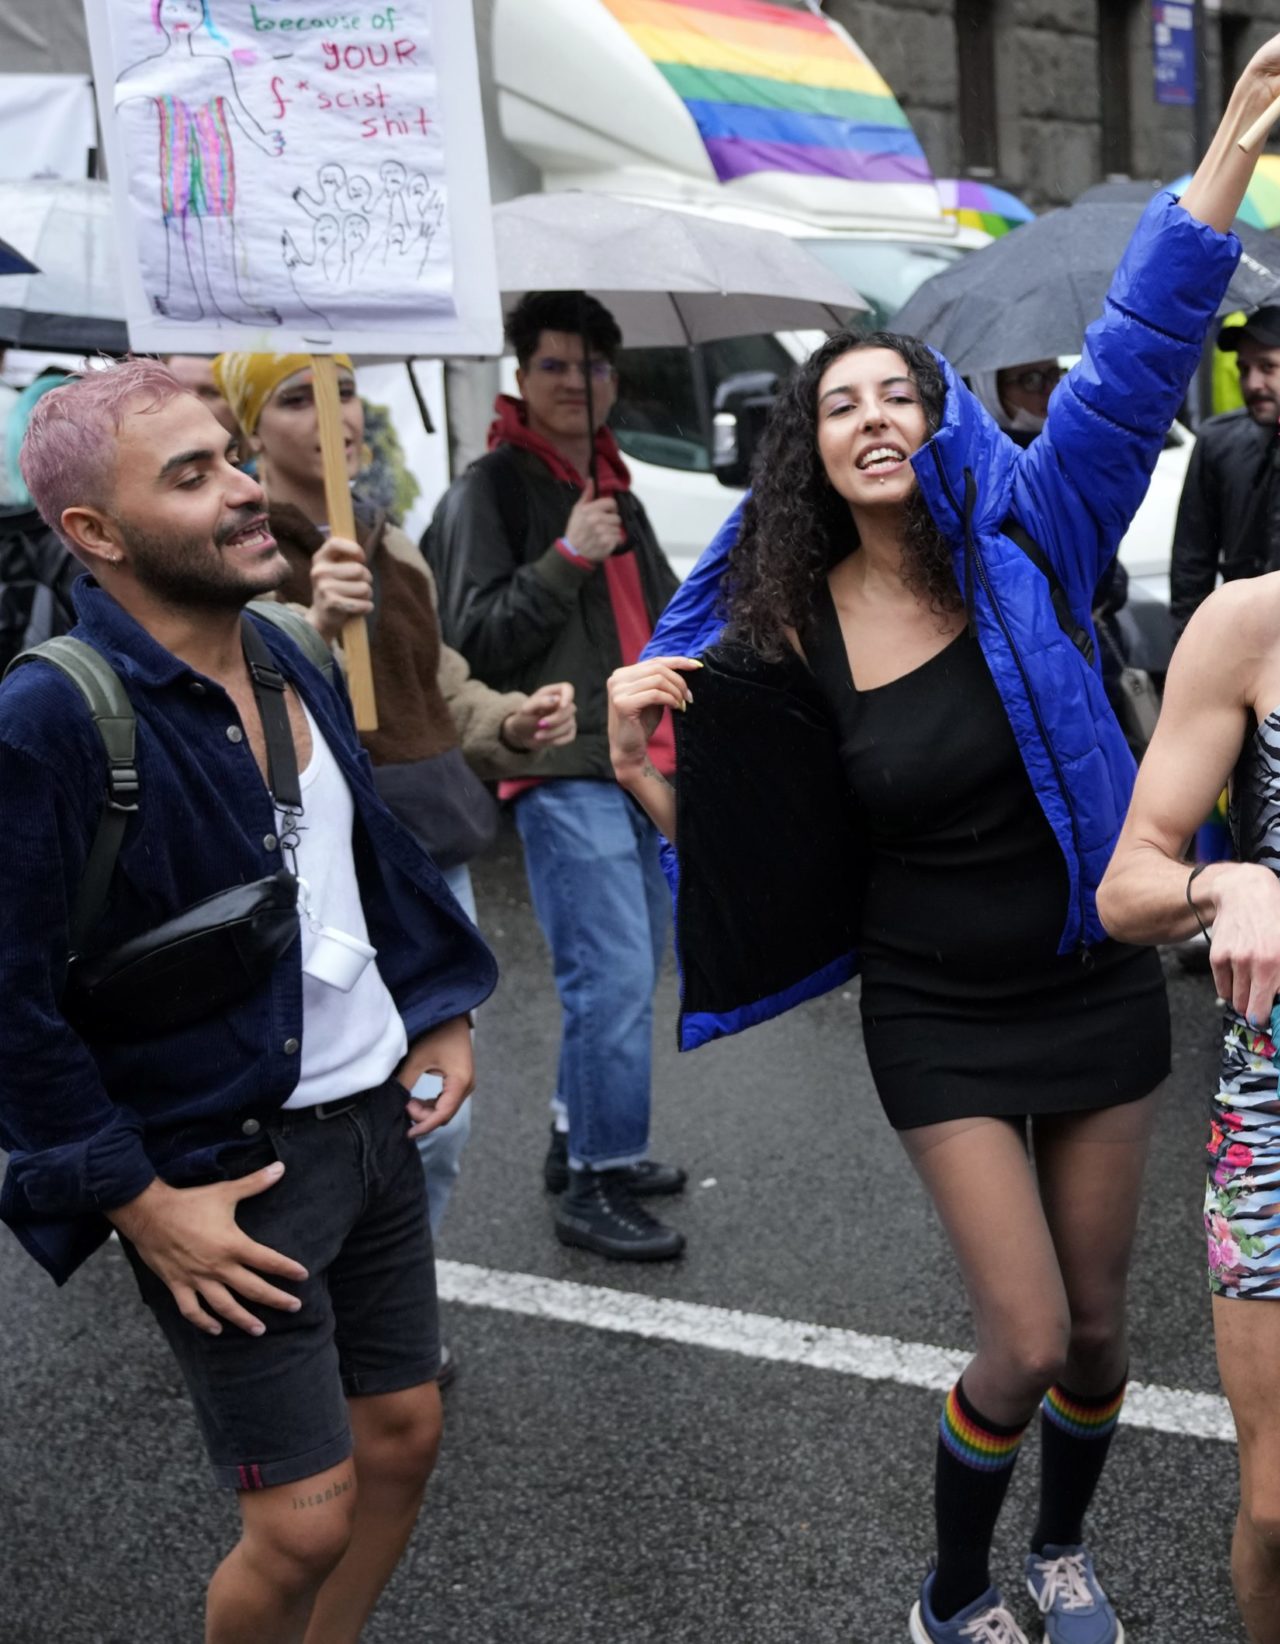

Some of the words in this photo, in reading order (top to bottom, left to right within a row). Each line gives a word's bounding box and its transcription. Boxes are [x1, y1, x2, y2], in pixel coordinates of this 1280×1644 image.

[250, 4, 361, 32] because
[371, 7, 400, 32] of
[321, 39, 418, 71] YOUR
[361, 107, 433, 138] shit
